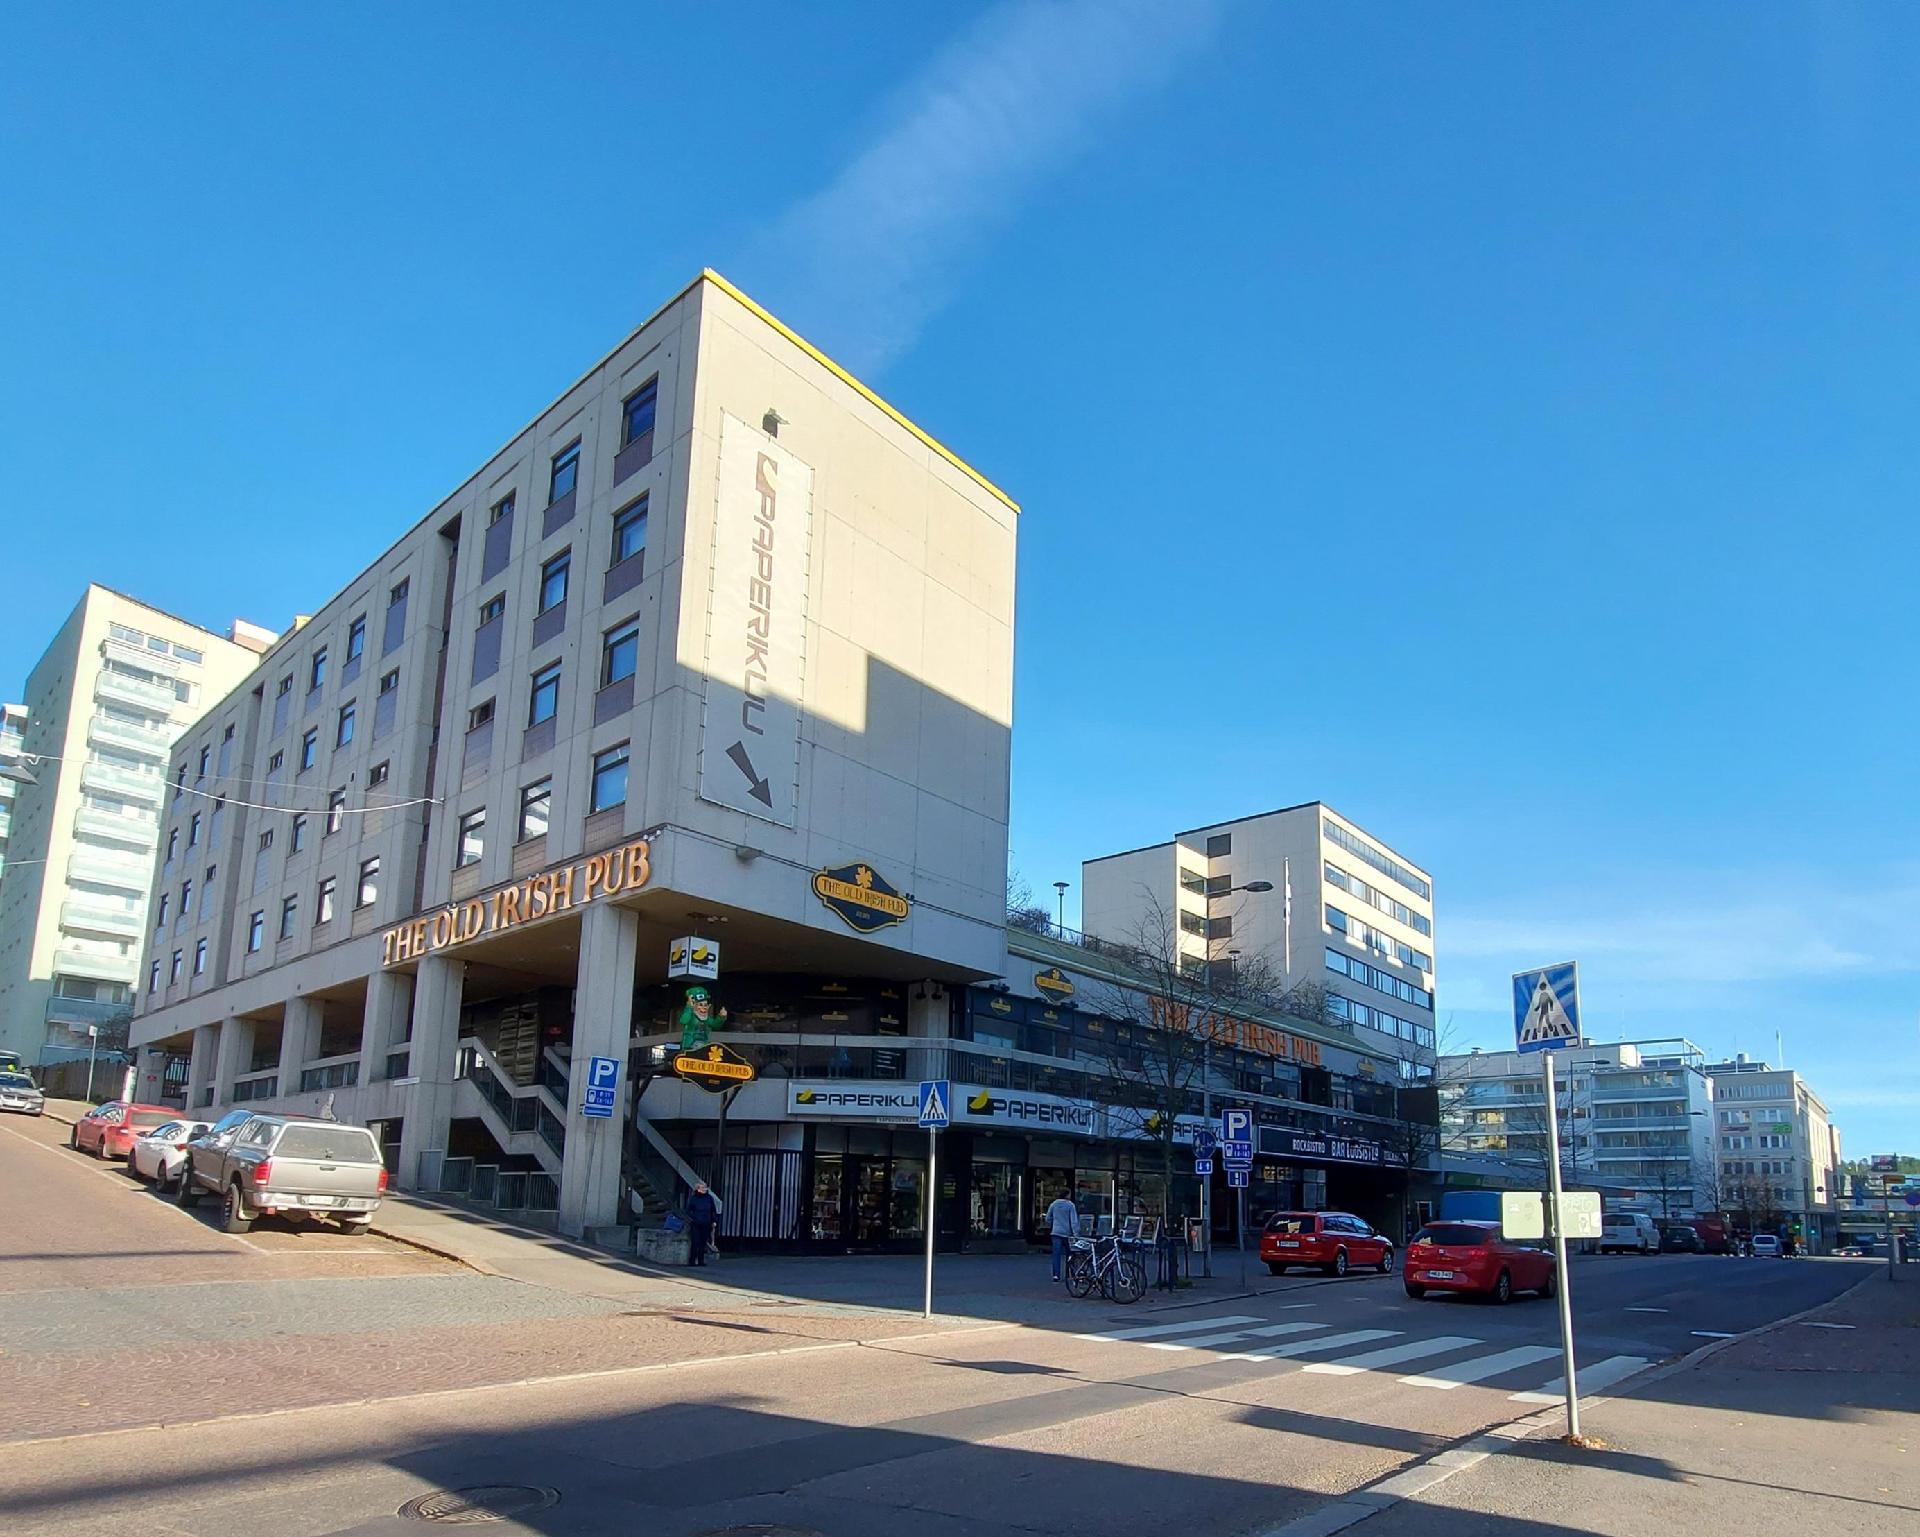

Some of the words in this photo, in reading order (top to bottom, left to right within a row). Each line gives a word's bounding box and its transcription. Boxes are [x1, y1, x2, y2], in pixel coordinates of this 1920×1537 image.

[741, 489, 777, 736] PAPERIKUU
[383, 917, 428, 966] THE
[431, 898, 485, 949] OLD
[491, 864, 576, 932] IRISH
[583, 839, 652, 903] PUB
[821, 878, 841, 896] THE
[844, 886, 863, 901] OLD
[865, 891, 885, 909] IRISH
[887, 898, 905, 913] PUB
[1242, 1022, 1288, 1057] IRISH
[1292, 1036, 1322, 1066] PUB
[594, 1060, 615, 1086] P
[814, 1093, 920, 1107] PAPERIKU
[1228, 1112, 1248, 1139] P
[1331, 1141, 1346, 1157] BAR
